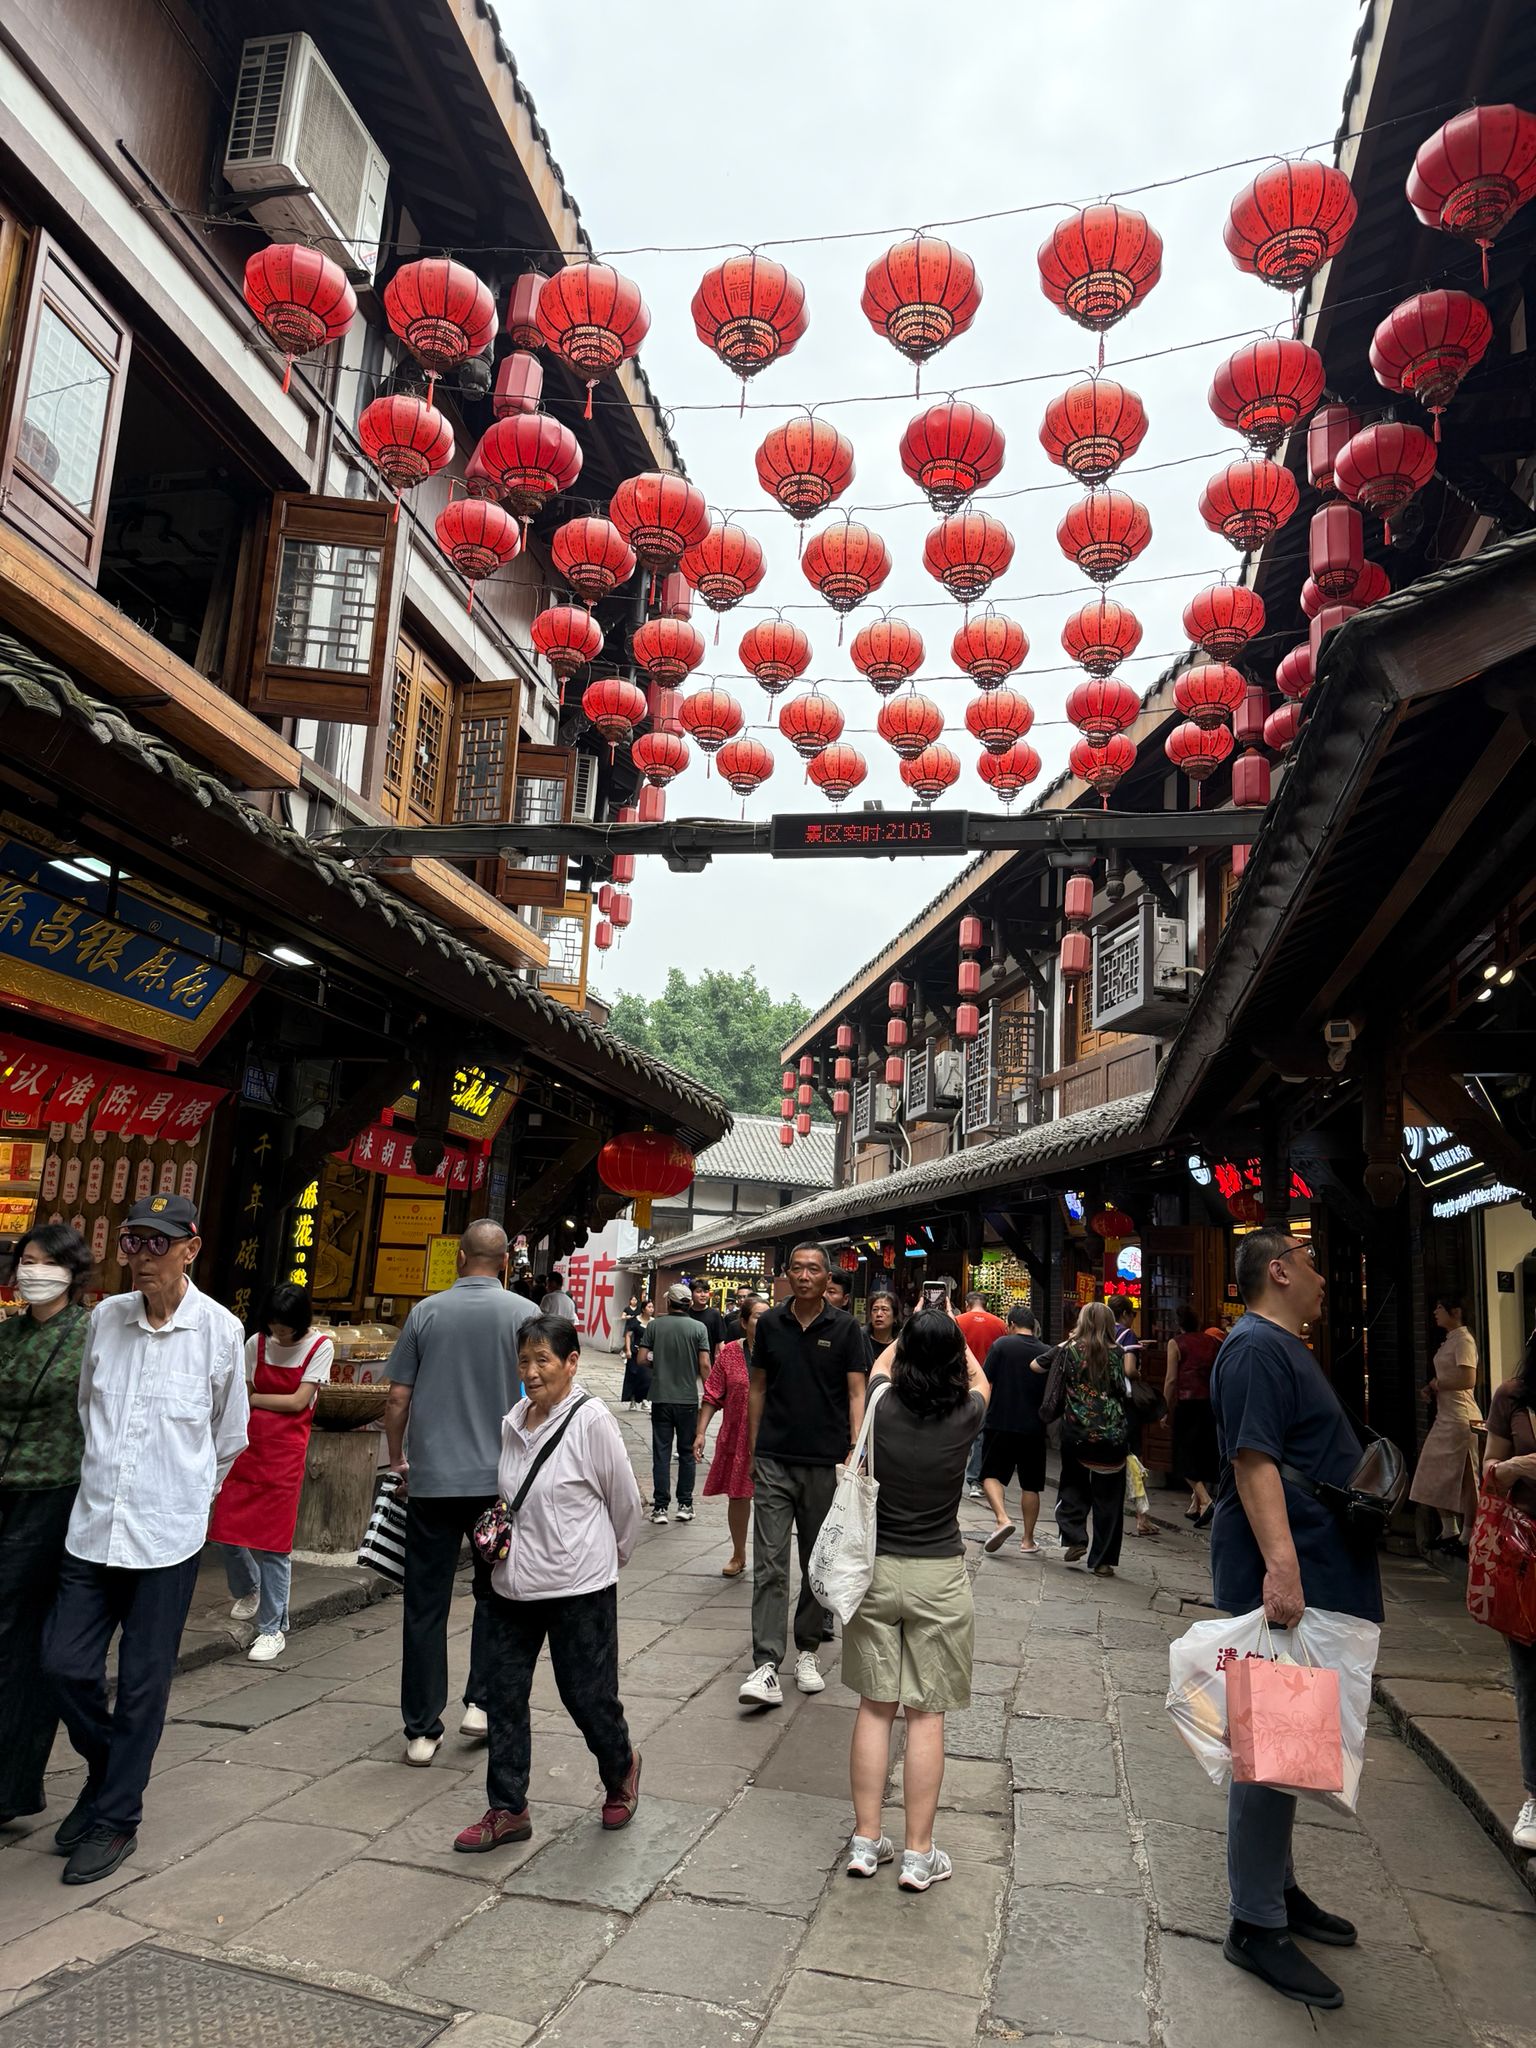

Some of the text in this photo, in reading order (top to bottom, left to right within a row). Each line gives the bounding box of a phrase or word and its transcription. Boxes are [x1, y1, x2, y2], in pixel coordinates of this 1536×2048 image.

[0, 1053, 211, 1127] 认准陈昌银
[359, 1131, 487, 1184] 味胡豆做现卖
[710, 1253, 761, 1269] 小猪找茶
[568, 1251, 617, 1339] 重庆
